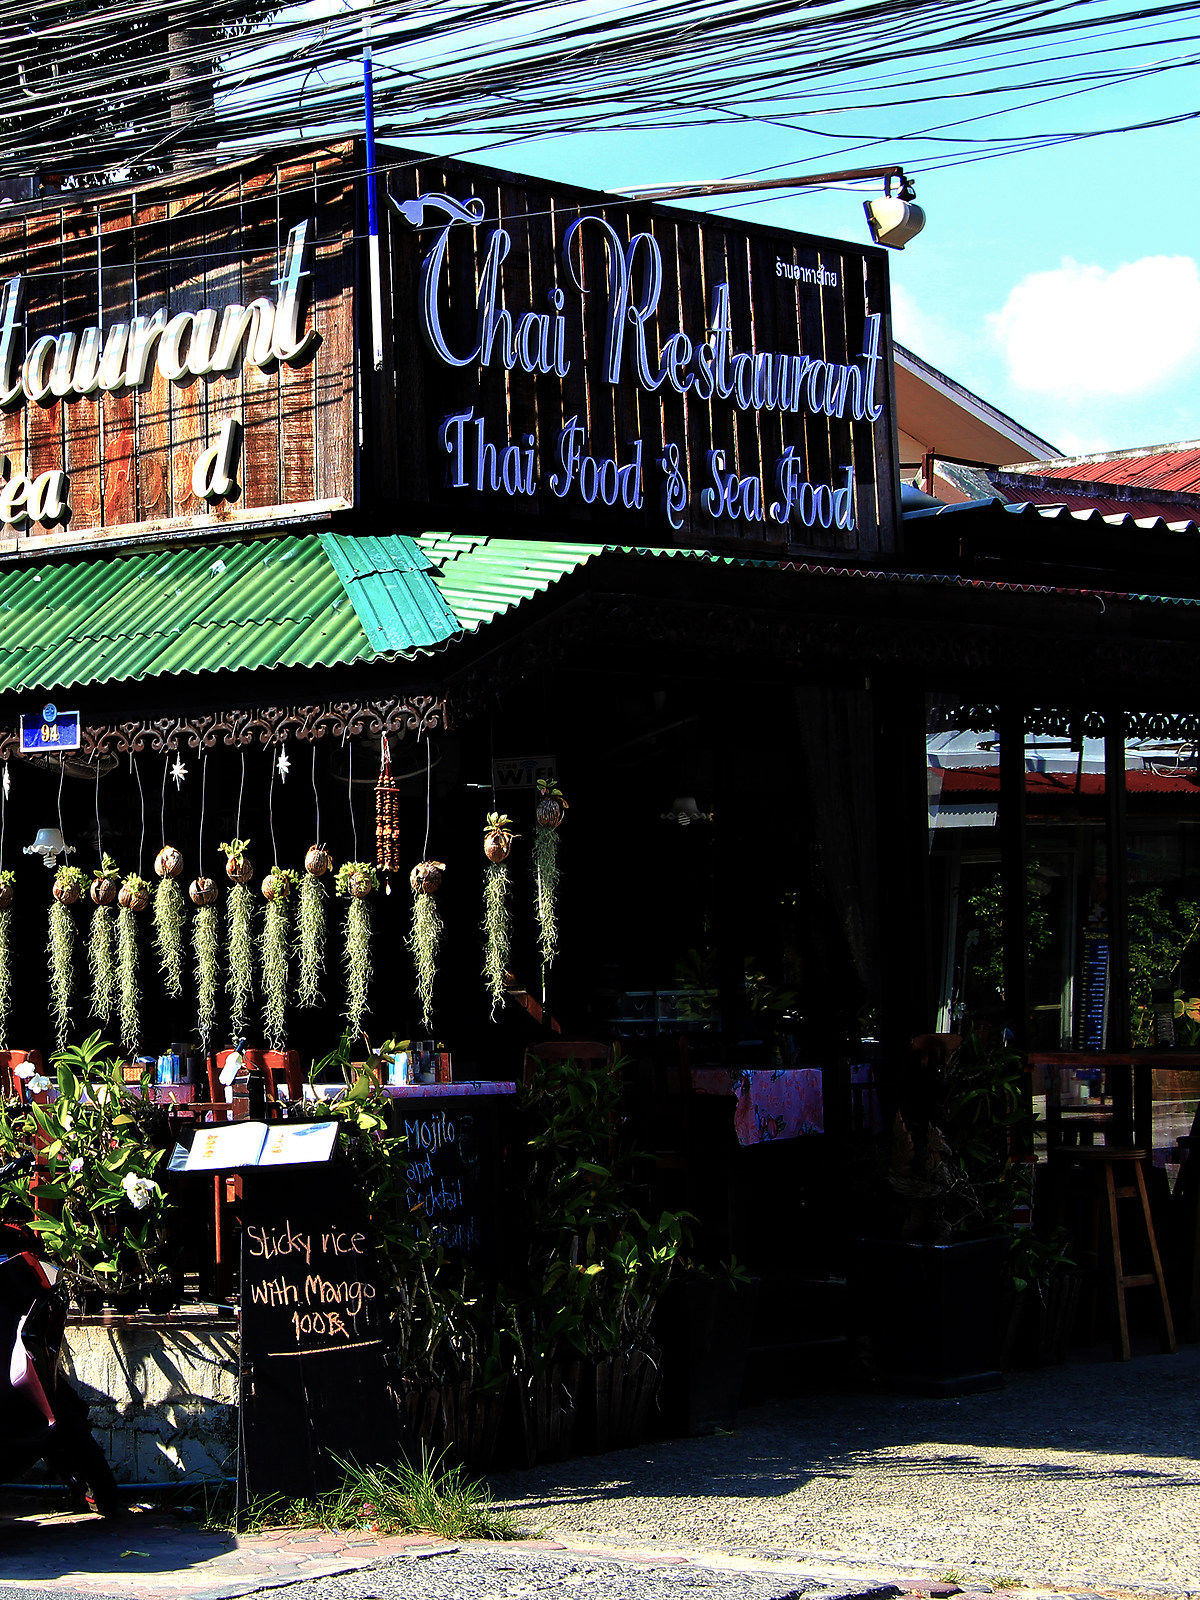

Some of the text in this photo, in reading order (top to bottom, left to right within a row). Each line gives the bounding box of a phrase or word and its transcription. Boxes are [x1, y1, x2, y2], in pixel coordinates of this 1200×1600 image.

[386, 193, 884, 421] Thai Restaurant
[440, 406, 855, 531] Thai Food & Sea Food
[40, 723, 60, 743] 94
[406, 1153, 435, 1184] and
[247, 1219, 311, 1265] Sticky
[321, 1225, 366, 1256] rice
[305, 1274, 376, 1317] Mango
